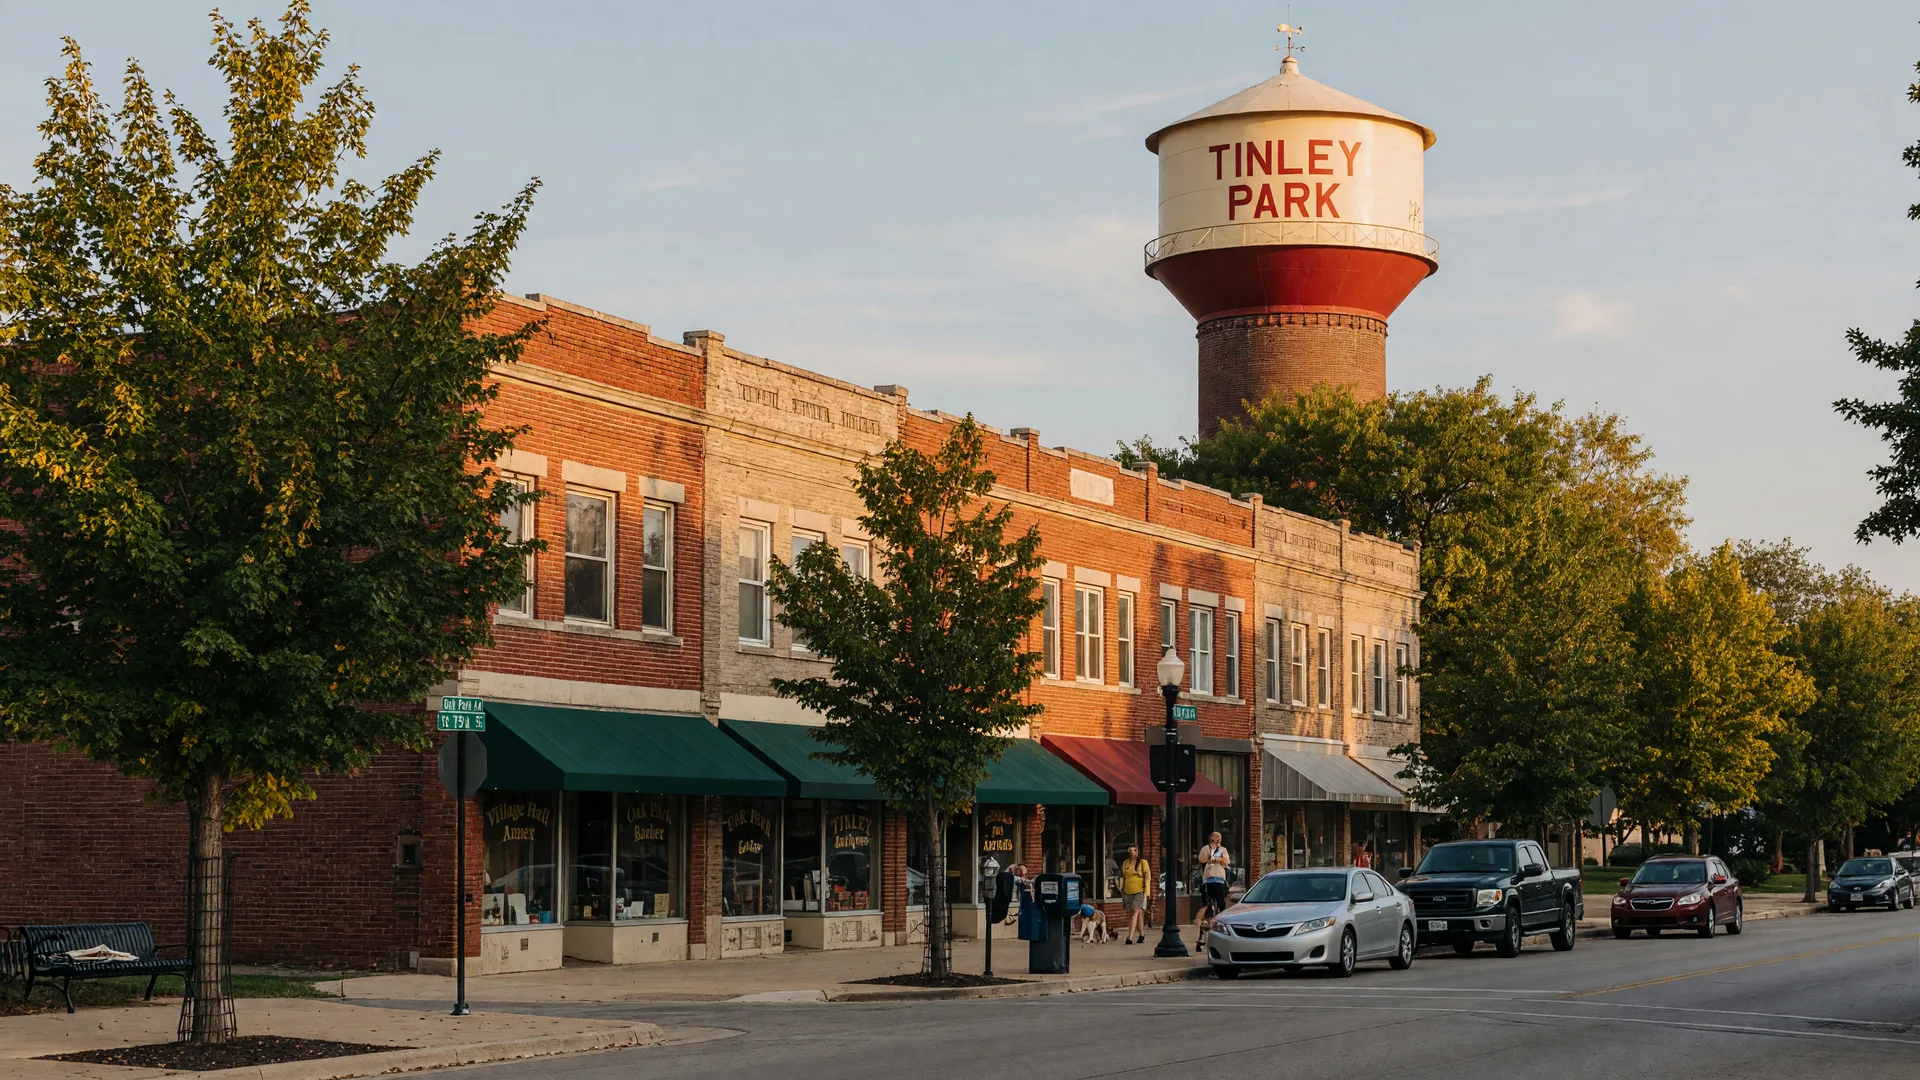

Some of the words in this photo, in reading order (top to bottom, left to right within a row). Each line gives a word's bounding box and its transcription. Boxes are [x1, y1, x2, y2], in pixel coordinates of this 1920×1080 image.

[1209, 140, 1362, 180] TINLEY
[1229, 182, 1340, 221] PARK
[485, 802, 525, 827] Village
[527, 801, 550, 827] Hall
[502, 824, 536, 843] Annex
[633, 823, 665, 843] Barber
